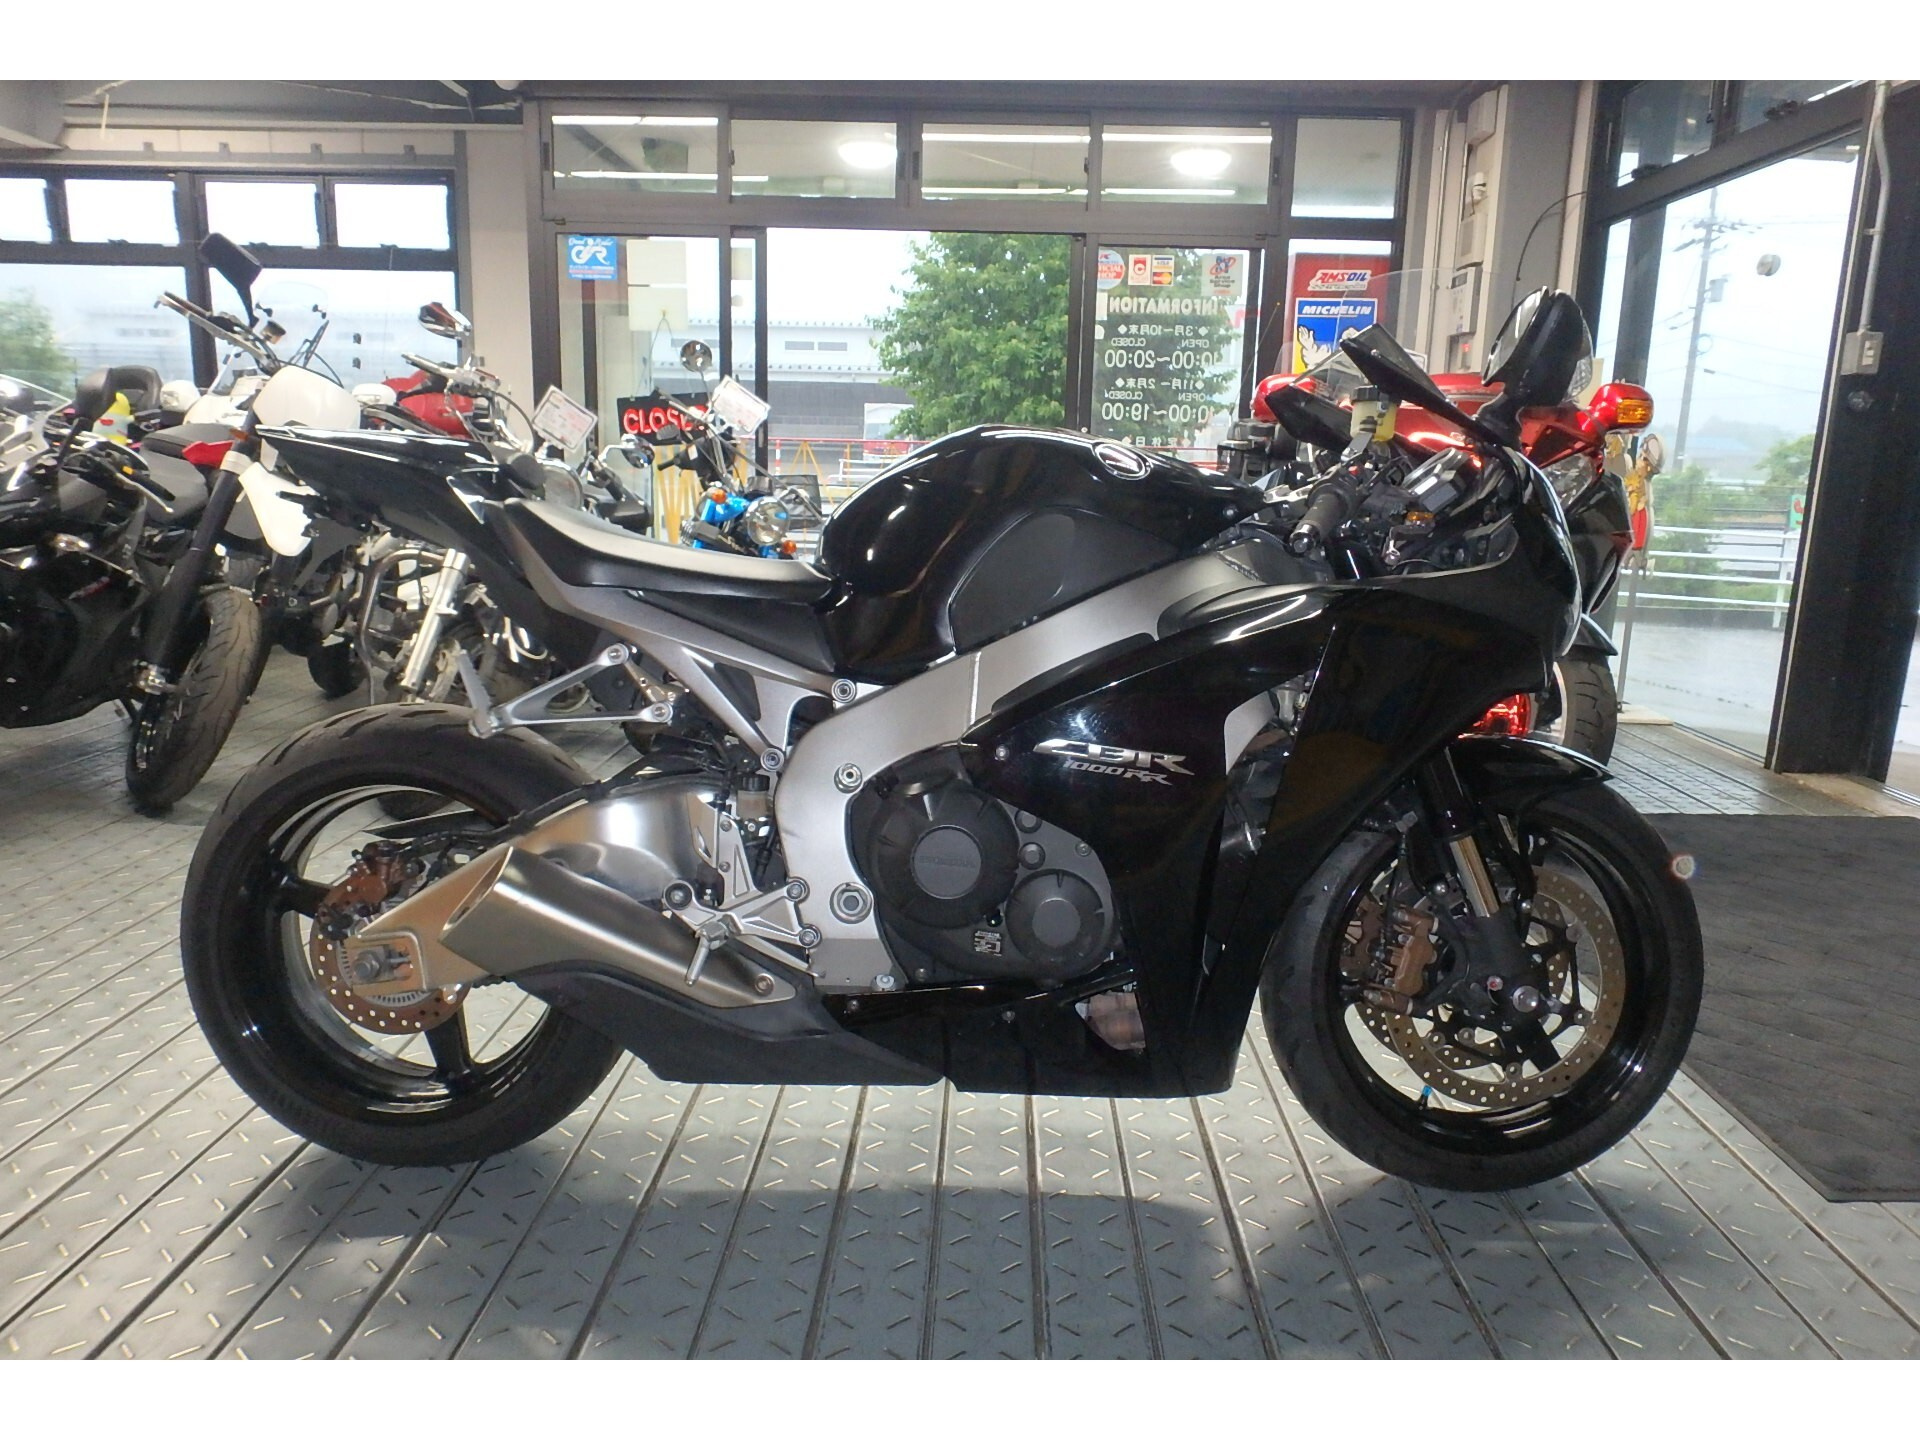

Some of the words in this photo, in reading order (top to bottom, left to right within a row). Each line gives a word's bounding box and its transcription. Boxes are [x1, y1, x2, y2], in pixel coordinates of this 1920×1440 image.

[1316, 272, 1367, 284] AMSOIL
[1302, 305, 1372, 315] MICHELIN
[1062, 758, 1173, 786] 1000RR
